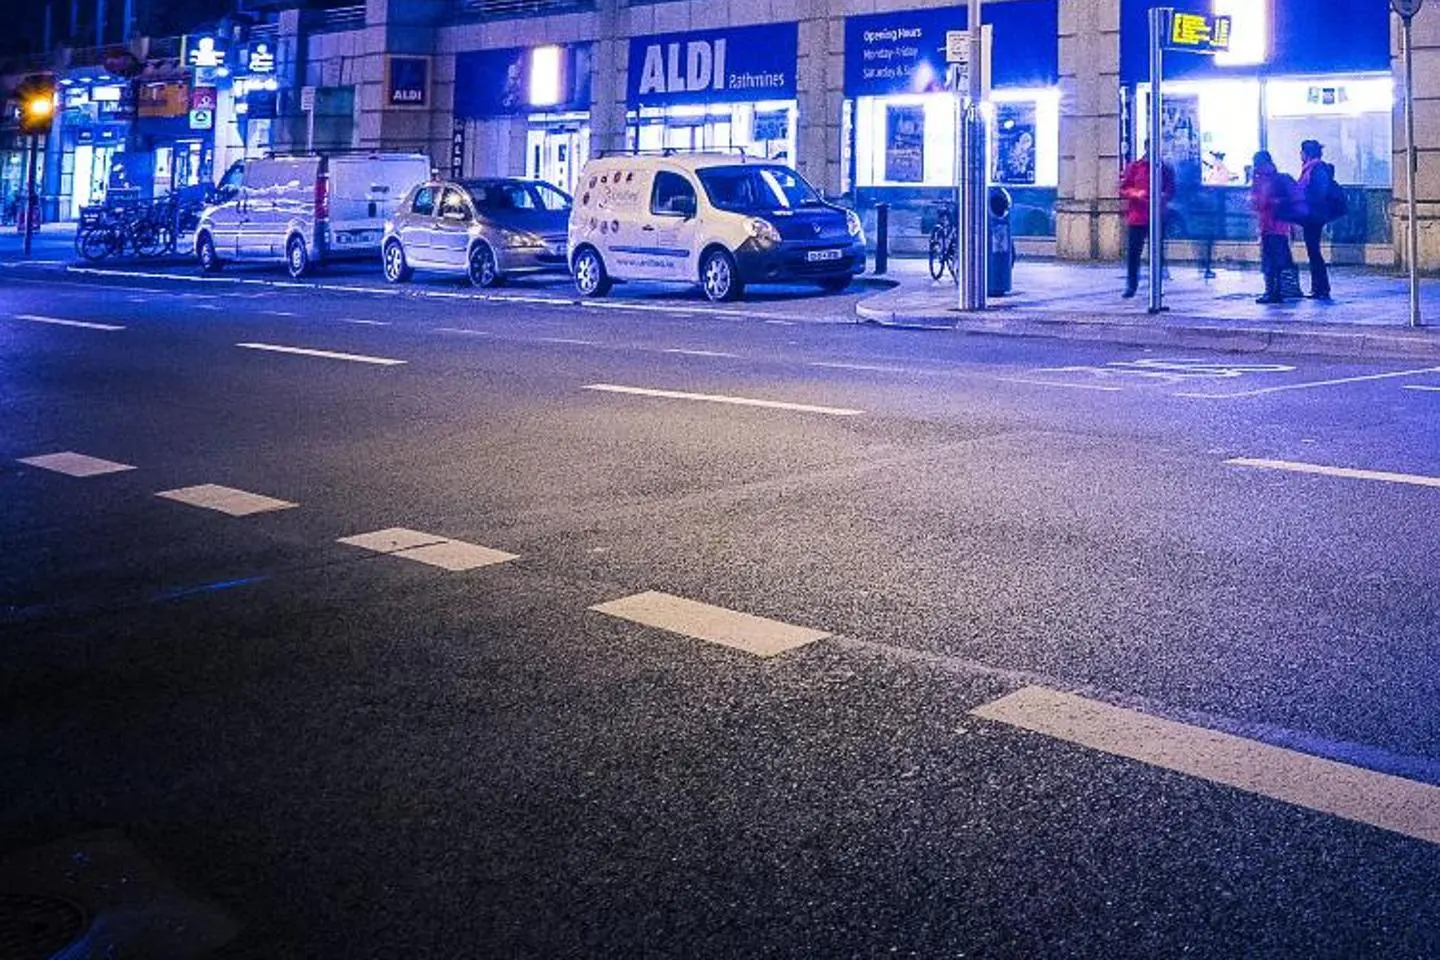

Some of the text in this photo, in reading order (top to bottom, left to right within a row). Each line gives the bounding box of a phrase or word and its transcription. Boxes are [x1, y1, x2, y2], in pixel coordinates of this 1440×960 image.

[863, 27, 922, 43] Opening Hours
[639, 38, 726, 95] ALDI
[729, 70, 785, 90] Rathmines
[393, 89, 422, 101] ALDI
[453, 134, 462, 178] ALDI
